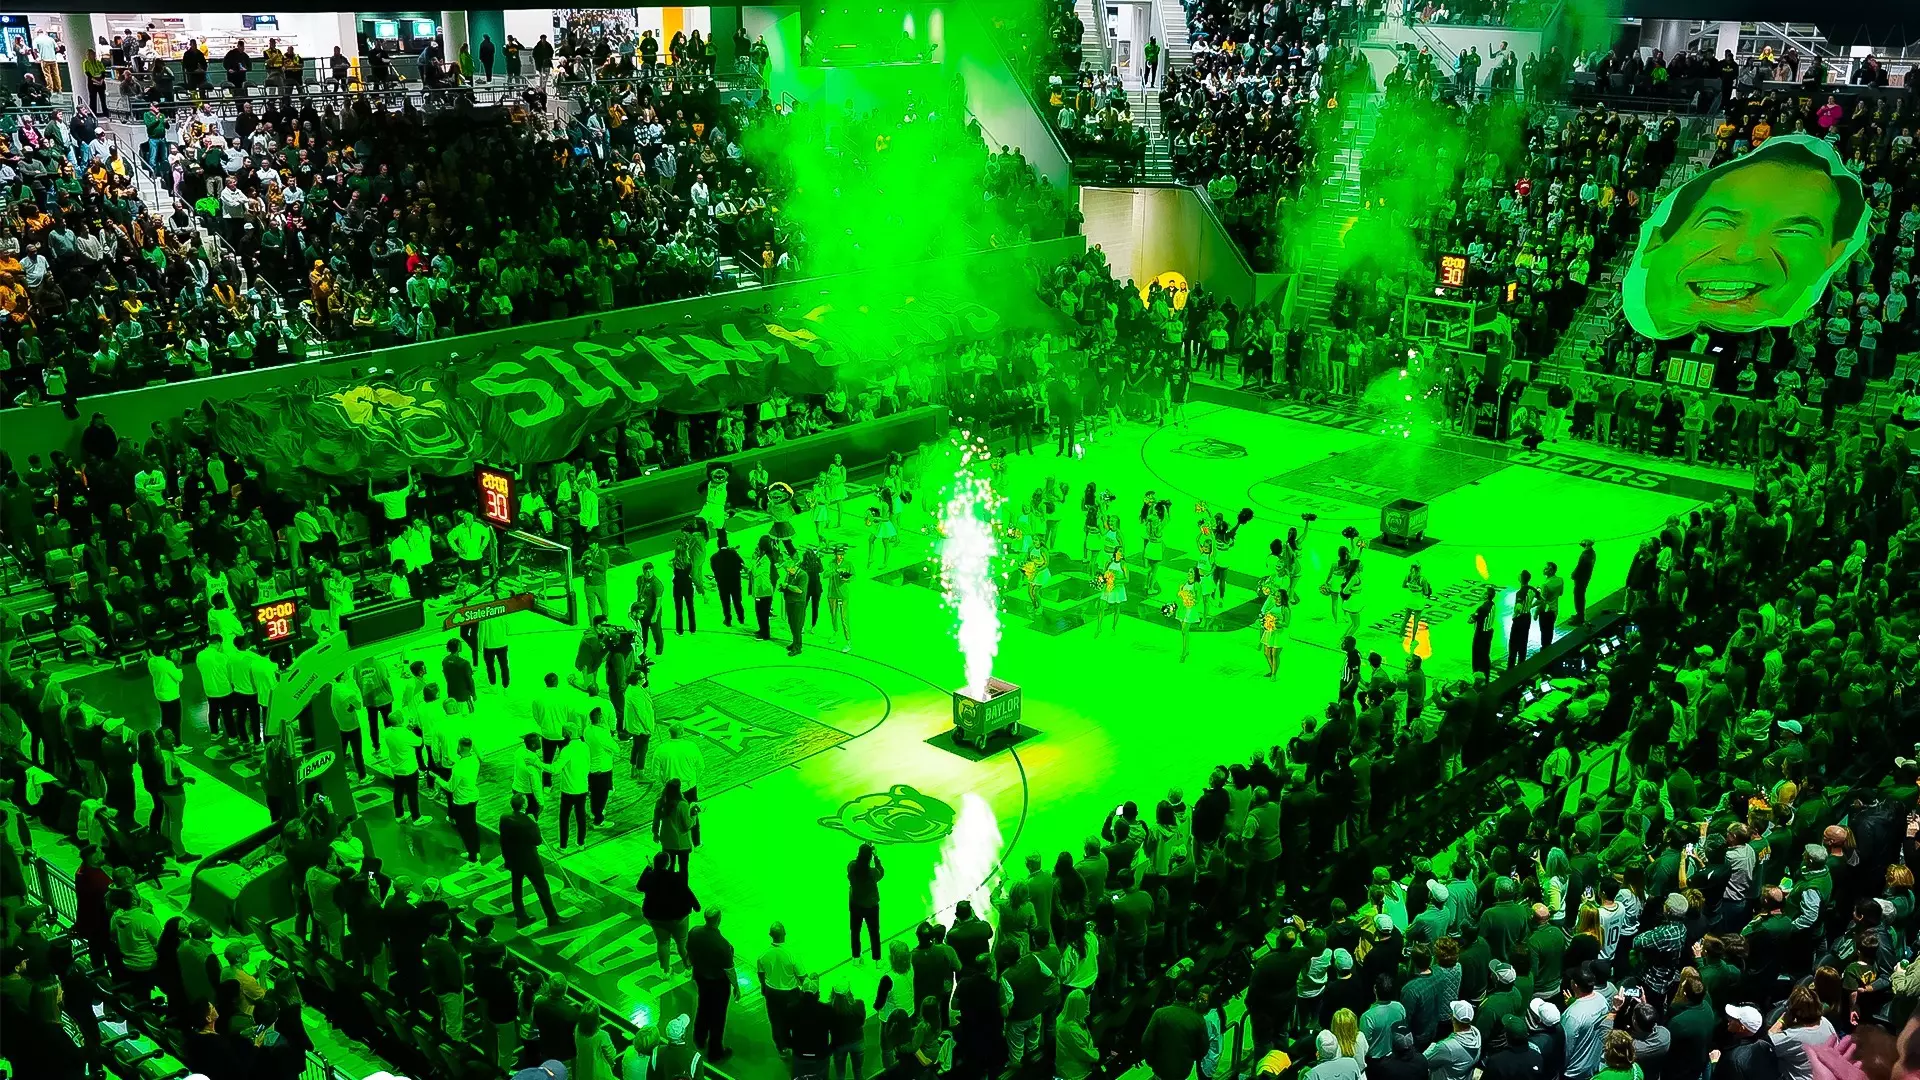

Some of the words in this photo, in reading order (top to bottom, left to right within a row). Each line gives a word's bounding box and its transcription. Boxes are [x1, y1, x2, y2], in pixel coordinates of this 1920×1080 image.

[1443, 267, 1462, 285] 30
[1506, 450, 1668, 488] BEARS
[482, 472, 509, 498] 20:00
[487, 490, 508, 520] 30
[258, 602, 293, 624] 20:00
[267, 618, 288, 638] 30
[985, 696, 1020, 722] BAYLOR
[297, 752, 332, 785] LIBMAN
[1606, 925, 1620, 947] 10
